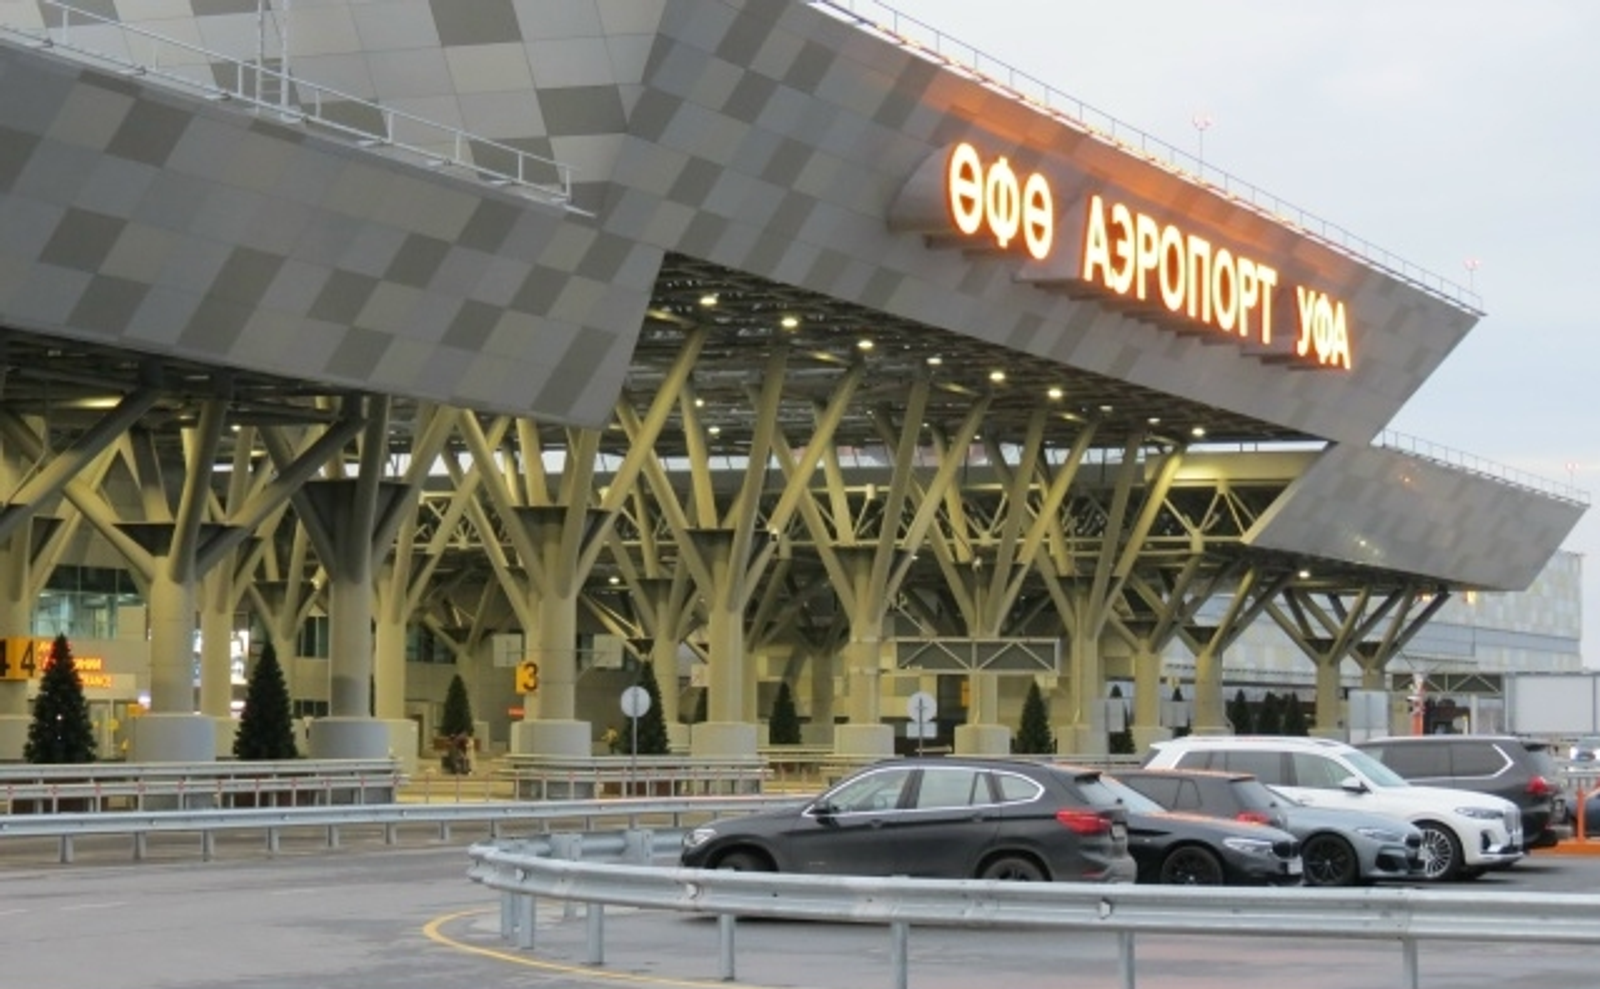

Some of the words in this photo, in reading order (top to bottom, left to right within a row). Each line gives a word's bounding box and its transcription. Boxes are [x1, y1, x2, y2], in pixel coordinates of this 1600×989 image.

[1083, 195, 1278, 344] АЭРОПОРТ
[1297, 285, 1351, 370] УФА
[20, 640, 36, 677] 4
[523, 663, 539, 691] 3
